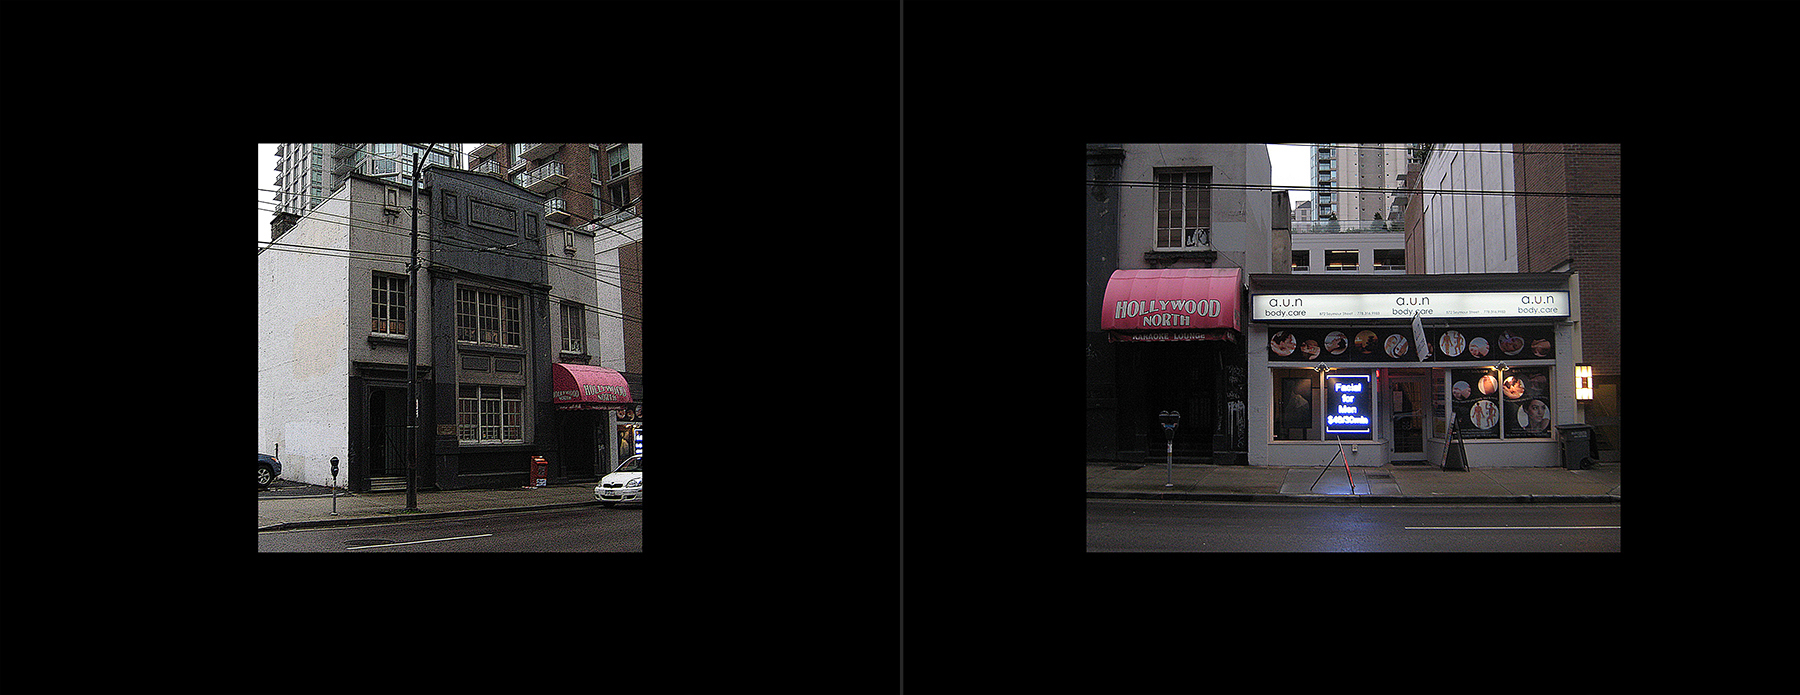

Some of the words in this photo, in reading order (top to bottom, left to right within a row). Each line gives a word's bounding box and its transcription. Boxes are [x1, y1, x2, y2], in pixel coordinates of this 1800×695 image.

[1268, 298, 1303, 307] a.u.n
[1396, 296, 1430, 306] a.u.n
[1521, 295, 1555, 304] a.u.n
[1114, 299, 1221, 319] HOLLYWOOD
[1265, 309, 1307, 318] body.care
[1392, 308, 1434, 316] body.care
[1517, 306, 1559, 314] body.care
[1143, 313, 1190, 327] NORTH
[583, 384, 627, 397] HOLLYWOOD
[1334, 382, 1362, 392] Facial
[1341, 393, 1355, 403] for
